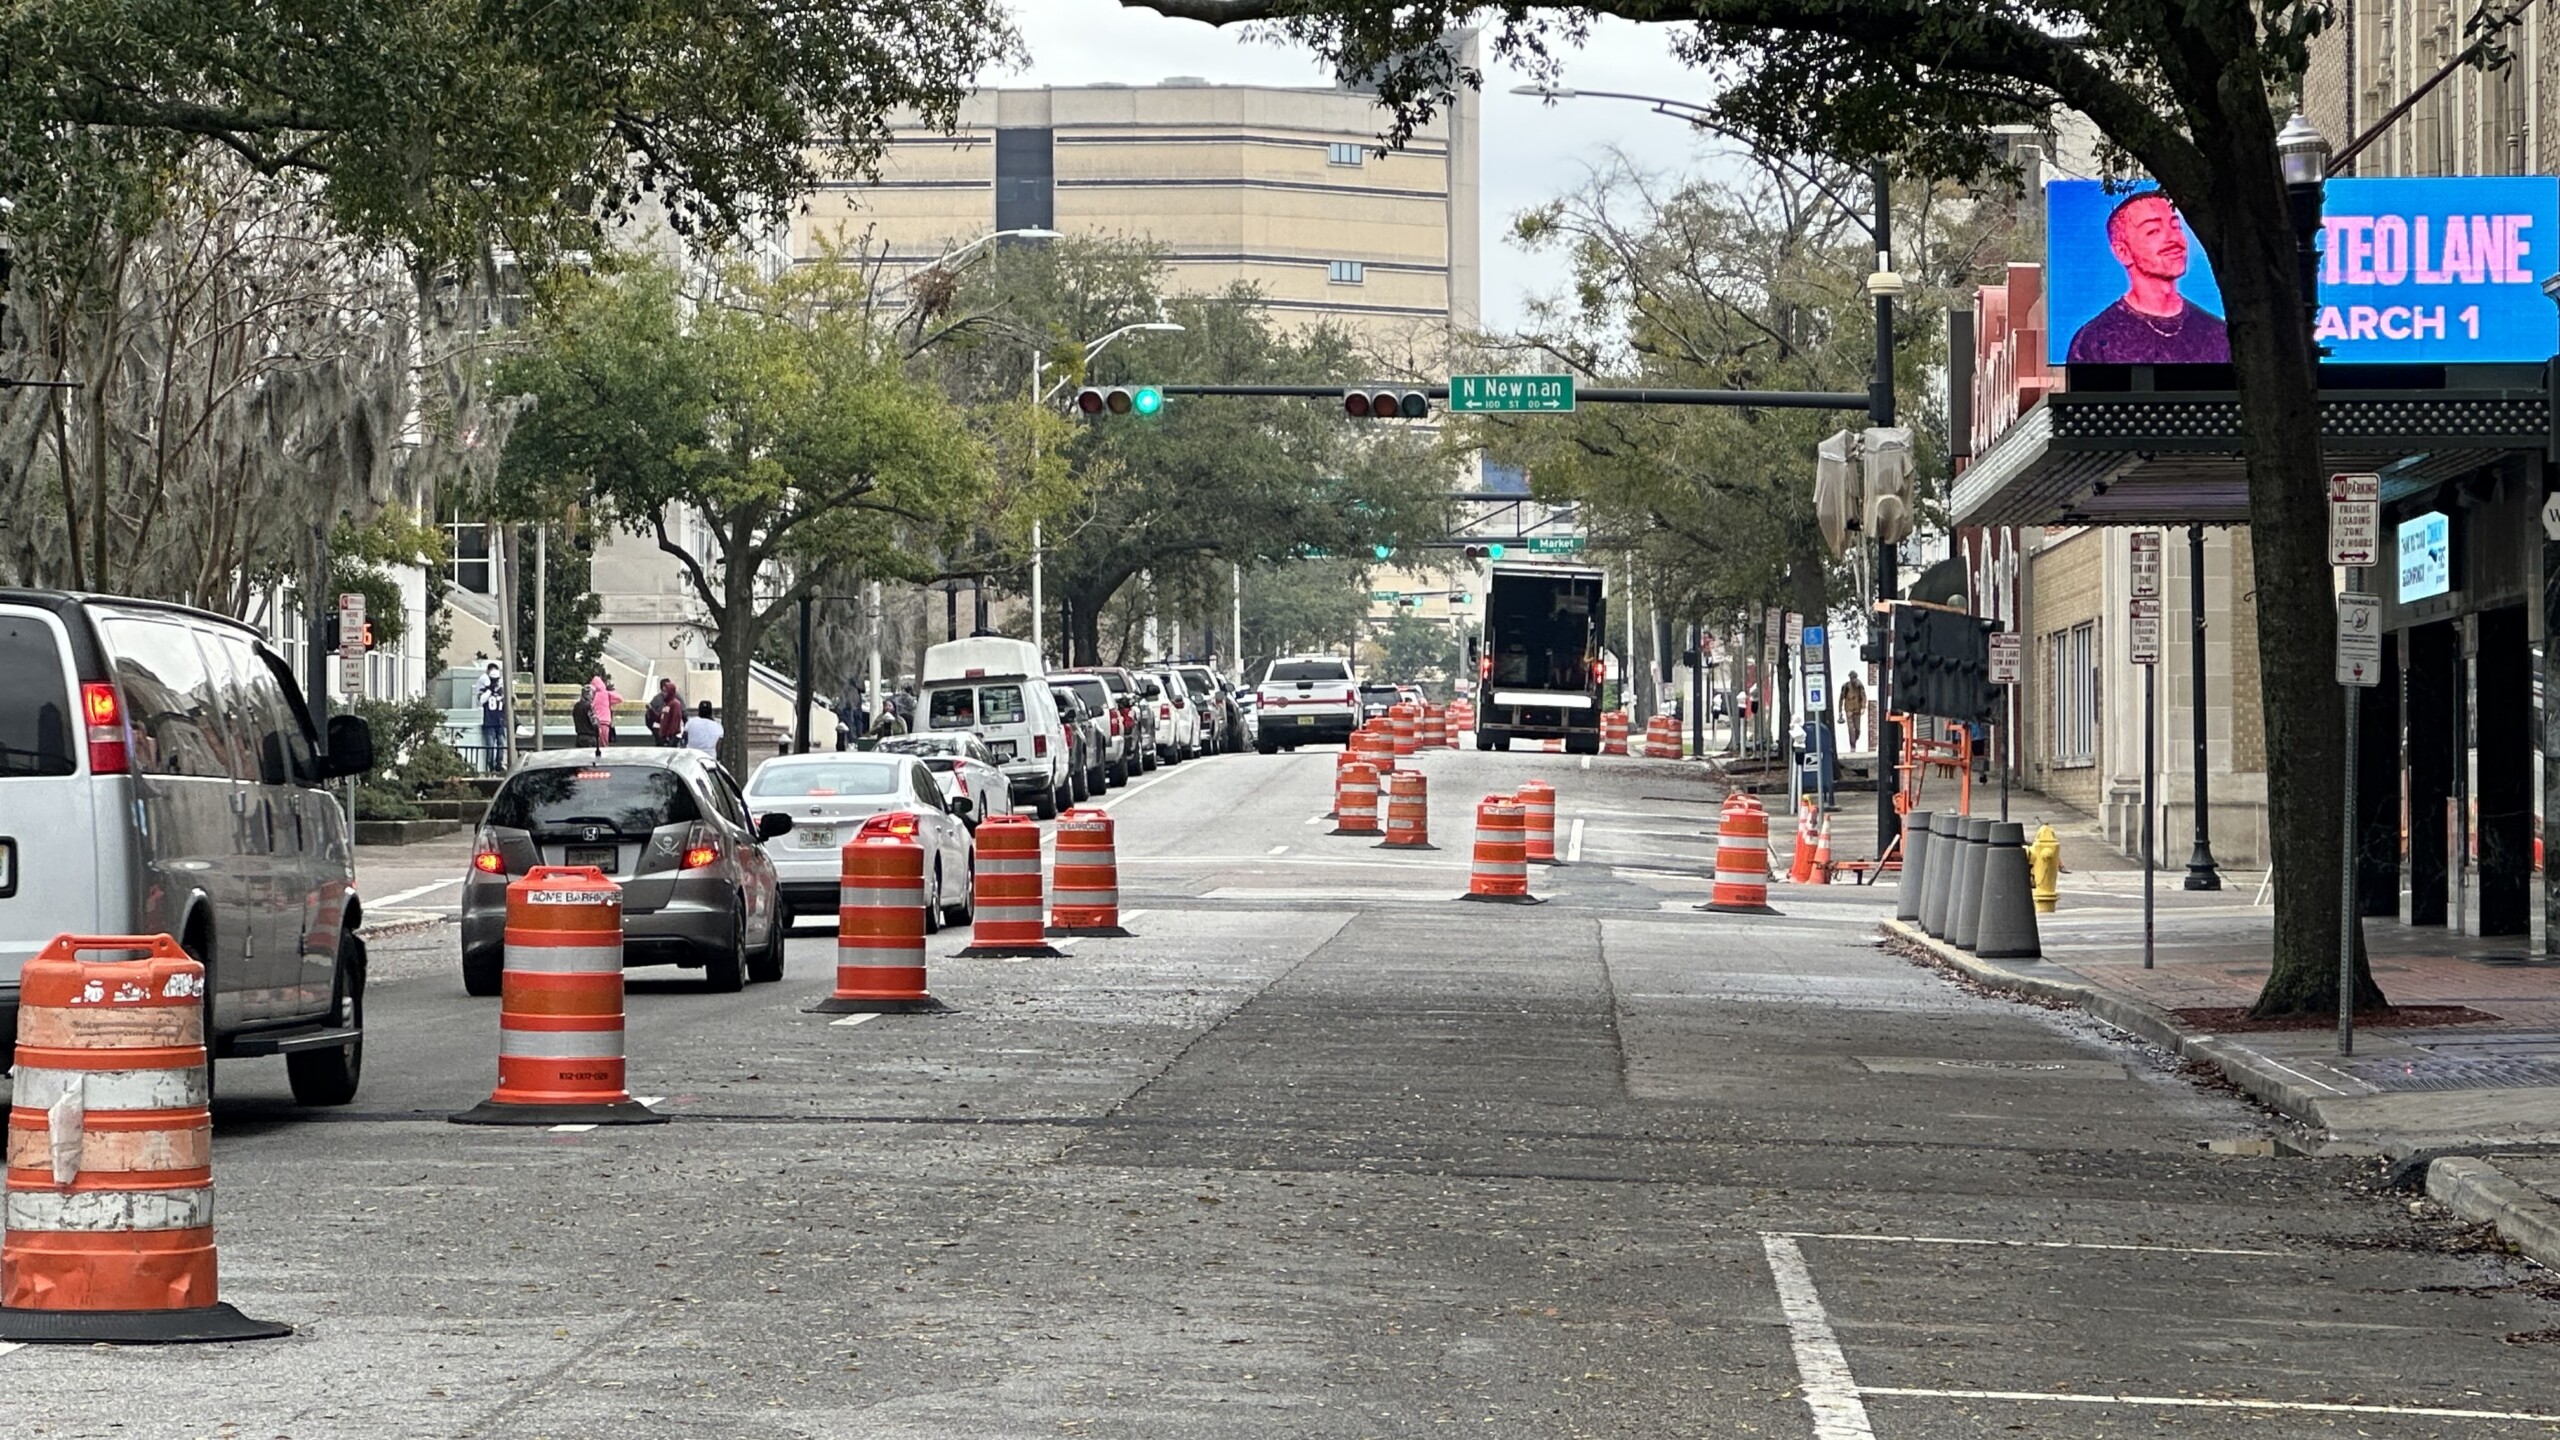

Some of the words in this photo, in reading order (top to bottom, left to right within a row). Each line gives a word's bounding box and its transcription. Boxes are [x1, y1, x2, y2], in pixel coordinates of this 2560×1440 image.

[2415, 215, 2533, 284] LANE
[2314, 305, 2445, 340] ARCH
[2459, 305, 2480, 340] 1
[1463, 379, 1475, 397] N
[1485, 379, 1561, 397] Newnan
[2333, 481, 2346, 497] NO
[2347, 483, 2377, 494] PARKING
[2339, 505, 2371, 514] FREIGHT
[2338, 516, 2371, 525] LOADING
[2345, 527, 2364, 536] ZONE
[1540, 538, 1574, 548] Market
[2335, 538, 2345, 548] 24
[2348, 538, 2373, 548] HOURS
